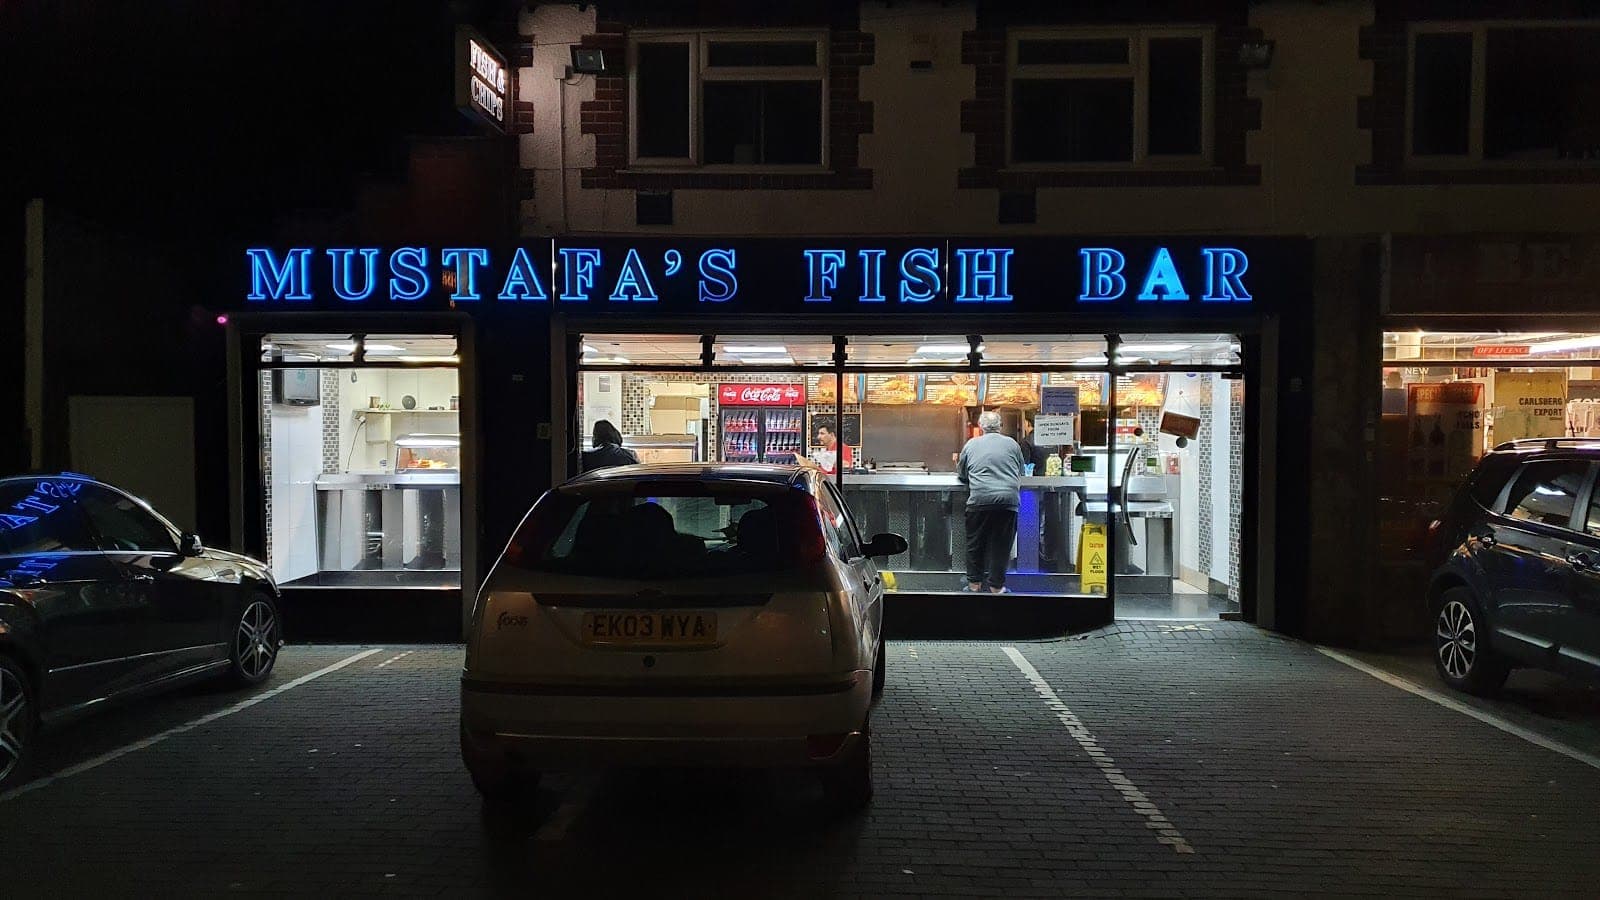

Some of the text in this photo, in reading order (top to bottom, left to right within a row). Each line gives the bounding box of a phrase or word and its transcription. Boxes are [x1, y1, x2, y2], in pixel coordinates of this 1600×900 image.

[470, 39, 505, 94] FISH &
[471, 75, 503, 122] CHIPS
[803, 246, 1014, 303] FISH
[1079, 246, 1253, 303] BAR
[1404, 367, 1430, 375] NEW
[1519, 397, 1563, 406] CARLSBERG
[1534, 408, 1563, 417] EXPORT
[592, 614, 706, 639] EK03 WYA
